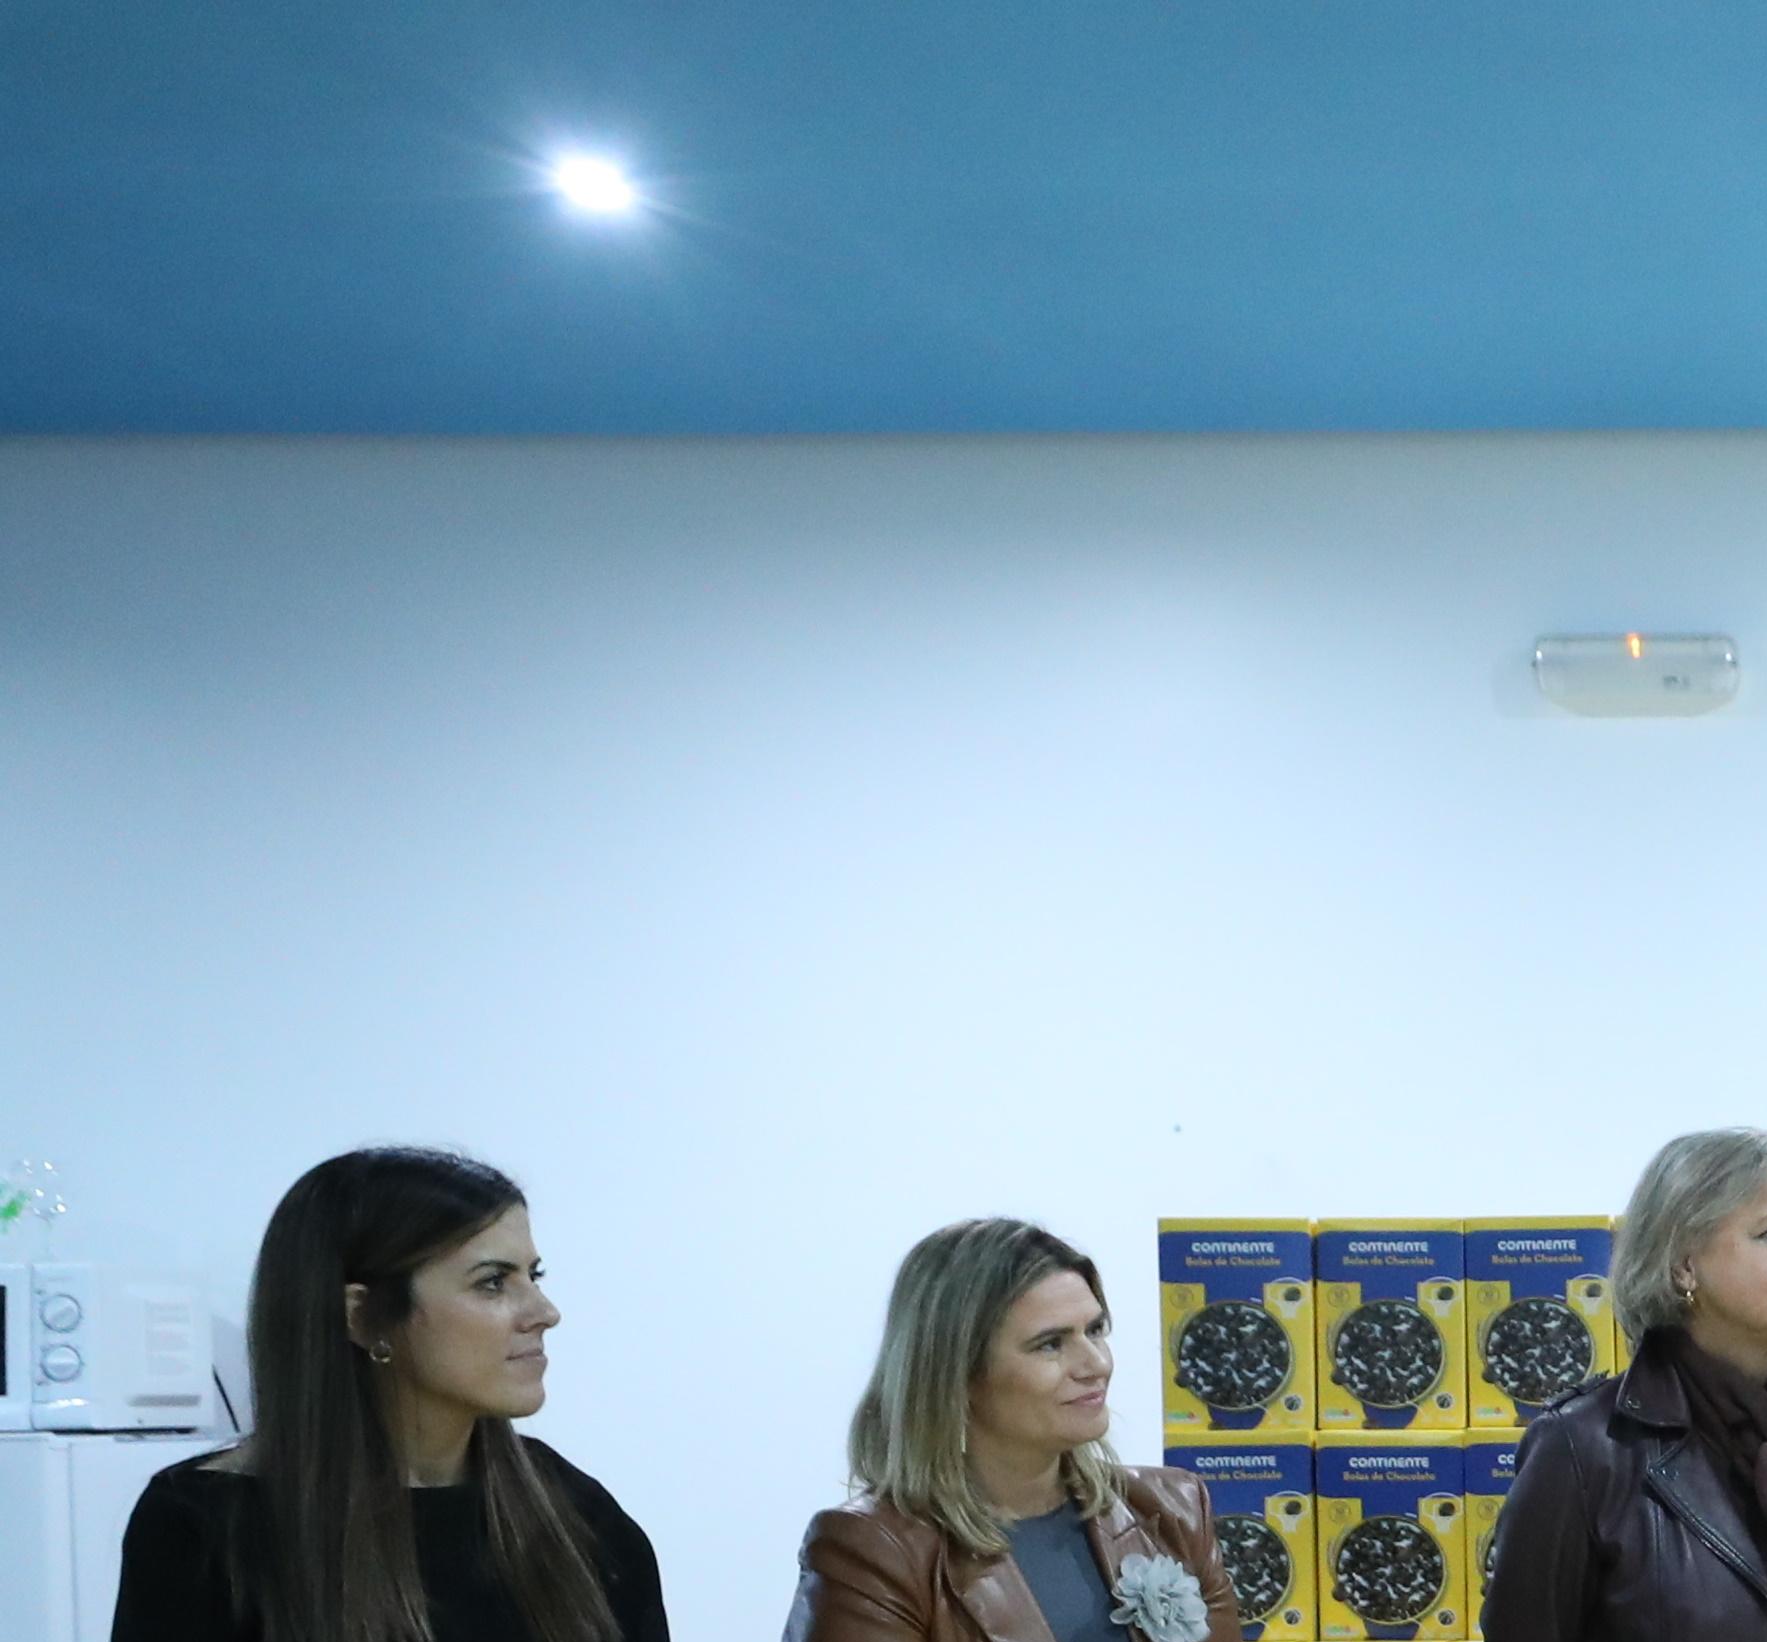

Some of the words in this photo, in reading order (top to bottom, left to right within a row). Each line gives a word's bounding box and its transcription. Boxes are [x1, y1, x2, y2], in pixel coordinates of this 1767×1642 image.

[1191, 1241, 1275, 1253] CONTINENTE
[1349, 1241, 1428, 1253] CONTINENTE
[1497, 1239, 1576, 1251] CONTINENTE
[1195, 1455, 1277, 1468] CONTINENTE
[1349, 1457, 1429, 1469] CONTINENTE
